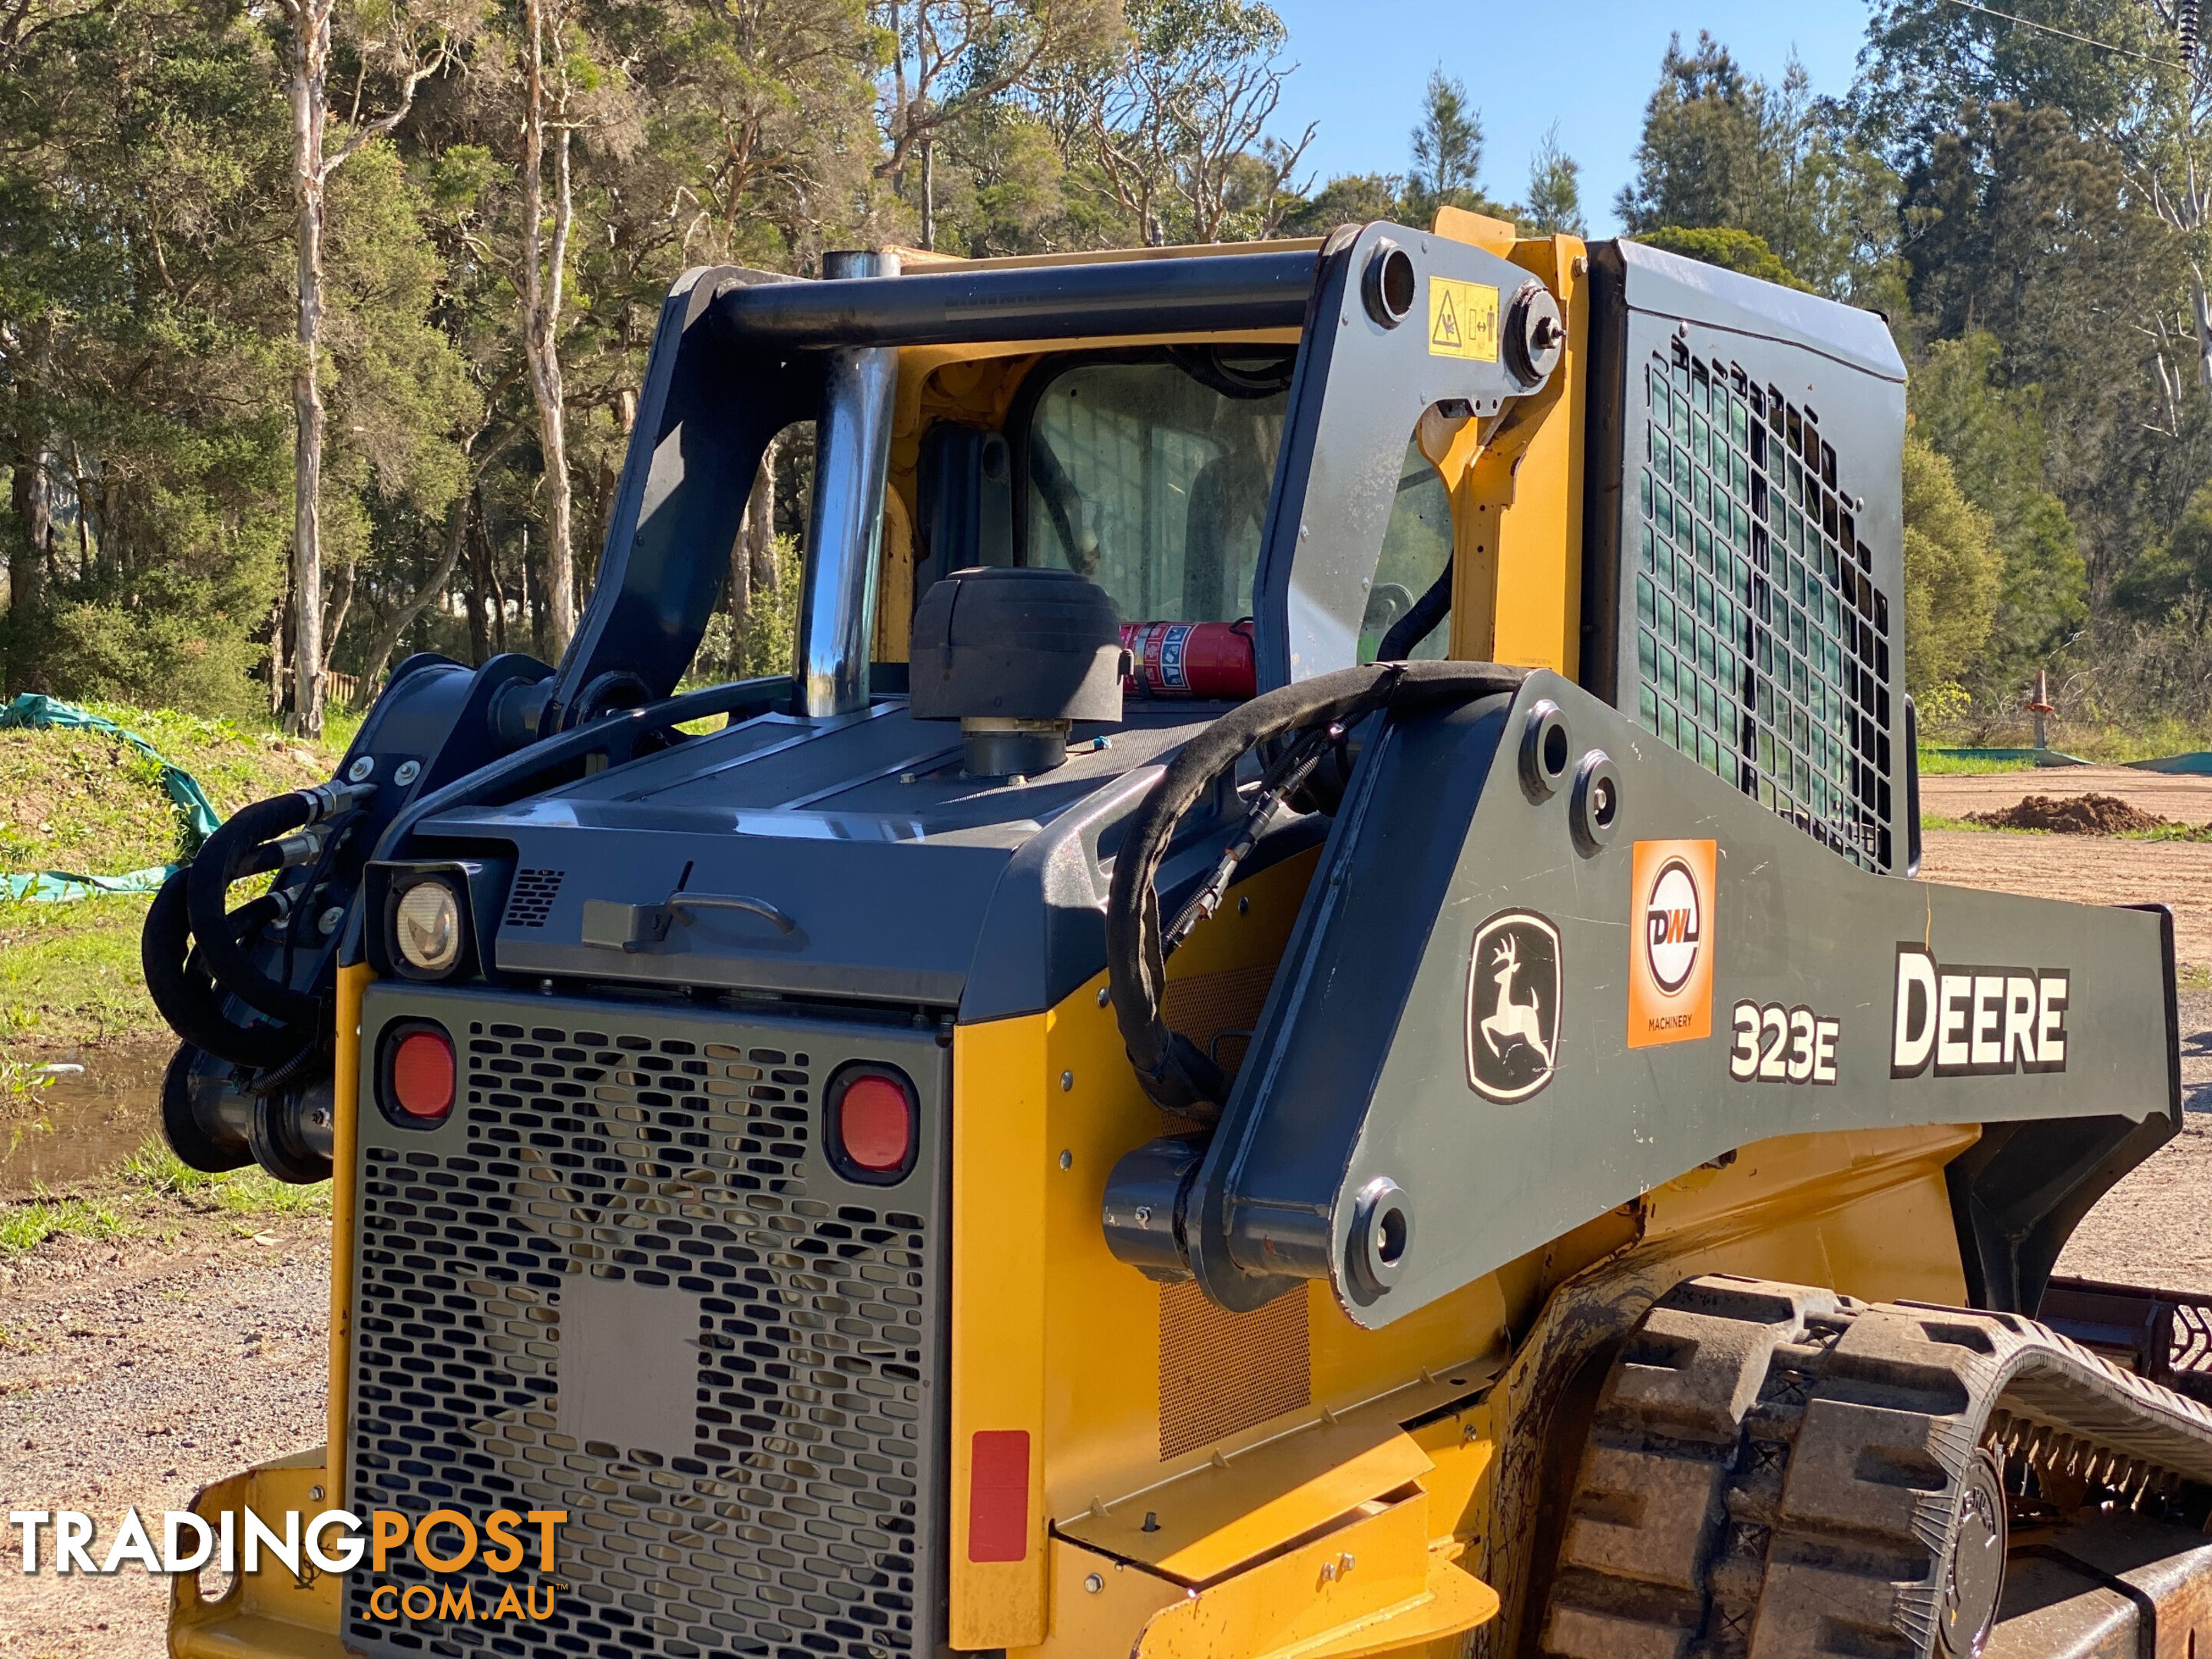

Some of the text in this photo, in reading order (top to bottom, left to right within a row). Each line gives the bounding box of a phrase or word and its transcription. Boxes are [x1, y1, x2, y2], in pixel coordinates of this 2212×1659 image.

[1647, 909, 1700, 945] DWL
[1648, 1014, 1693, 1032] MACHINERY
[1891, 943, 2069, 1077] DEERE
[1730, 1000, 1839, 1084] 323E
